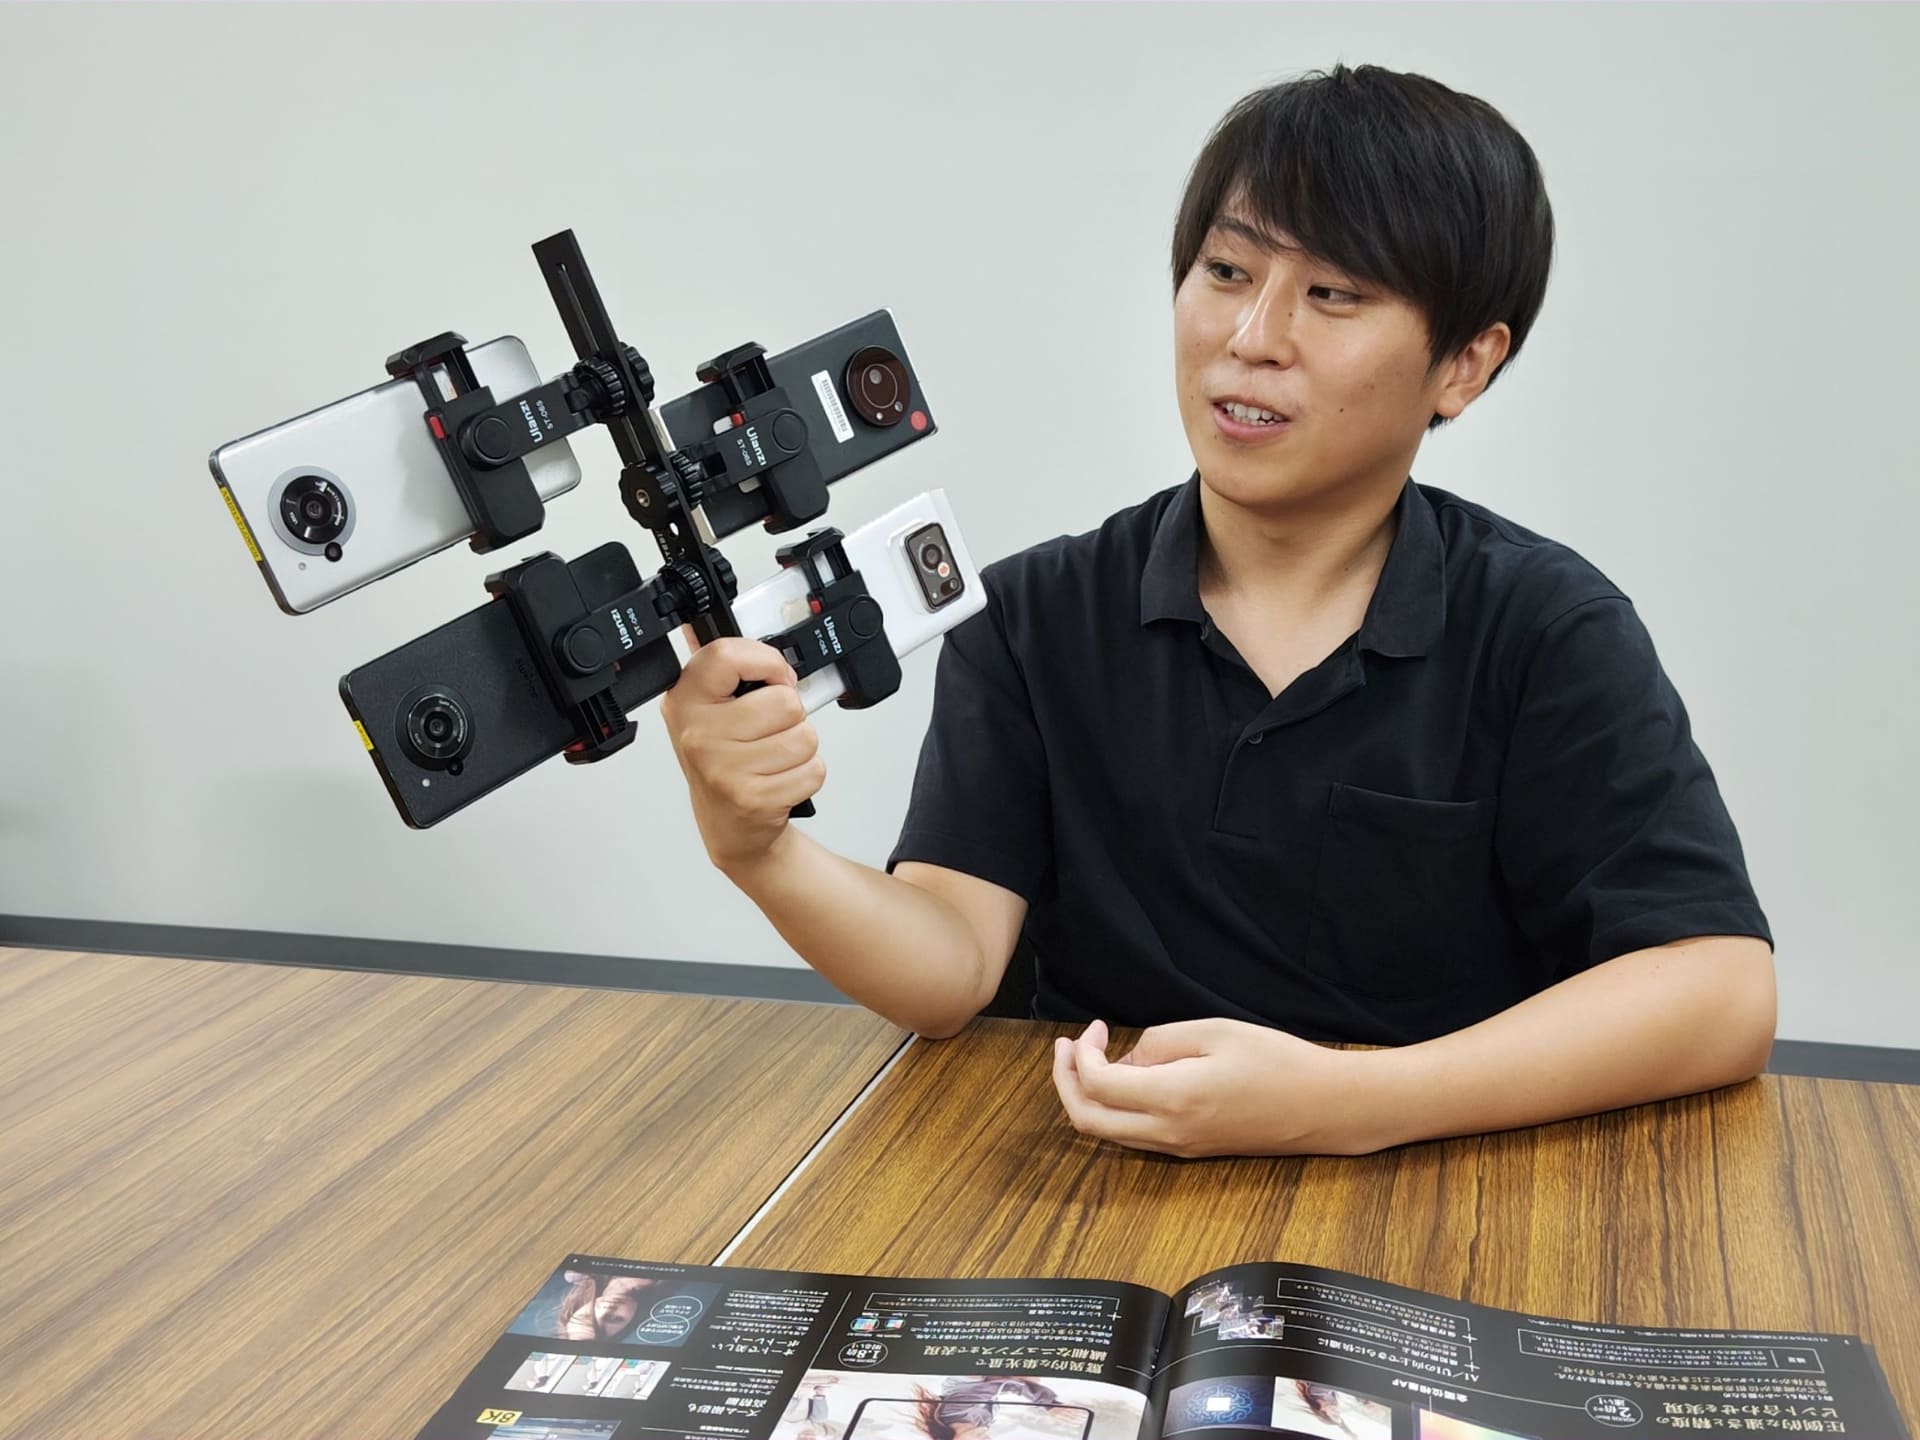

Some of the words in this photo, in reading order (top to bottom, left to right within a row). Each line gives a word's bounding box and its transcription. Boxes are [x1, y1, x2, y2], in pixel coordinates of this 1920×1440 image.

[519, 400, 543, 443] Ulanzi
[746, 426, 767, 466] Ulanzi
[611, 608, 633, 650] Ulanzi
[823, 615, 843, 655] Ulanzi
[481, 1411, 516, 1423] 8K
